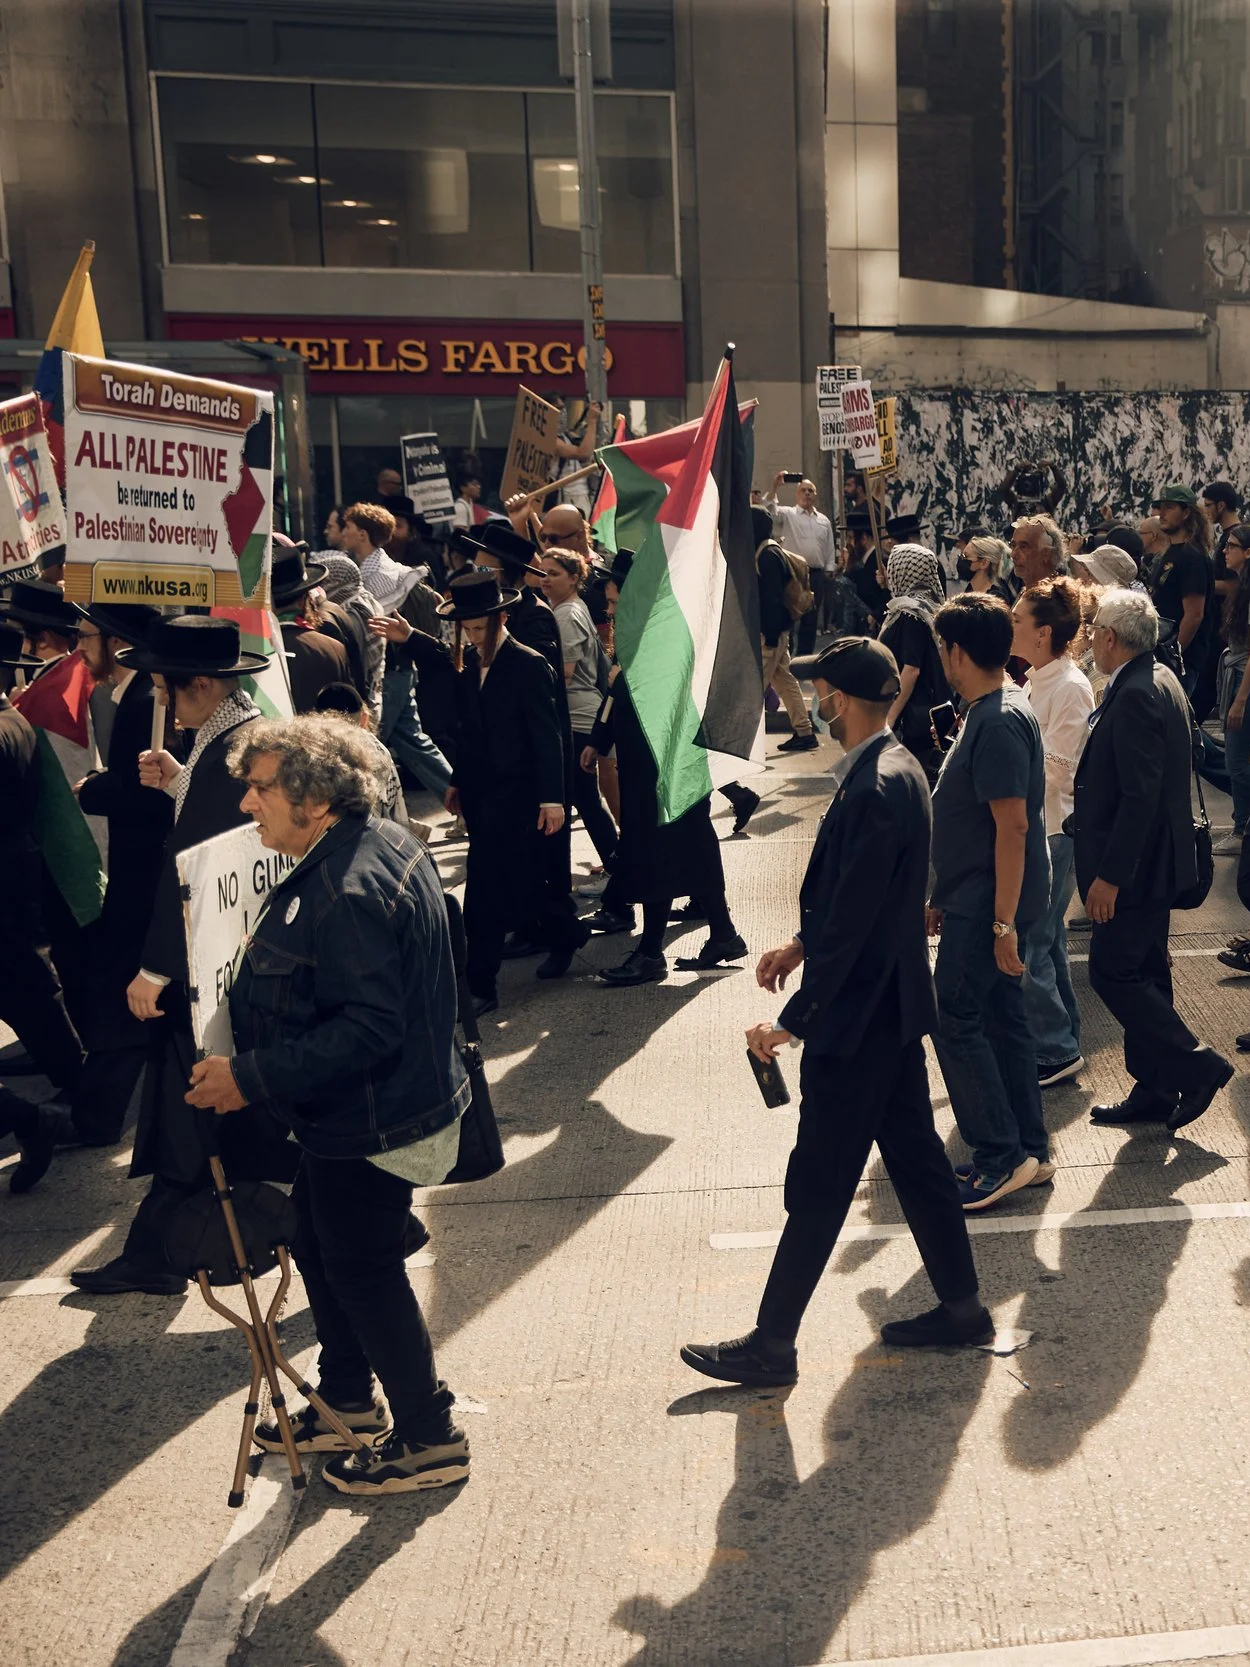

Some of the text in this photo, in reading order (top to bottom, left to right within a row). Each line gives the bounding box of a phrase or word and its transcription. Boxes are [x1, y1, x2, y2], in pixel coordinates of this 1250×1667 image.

[441, 340, 613, 375] FARGO
[820, 368, 858, 381] FREE
[101, 374, 240, 420] Torah Demands
[842, 388, 870, 415] ARMS
[522, 395, 549, 437] FREE
[822, 421, 845, 436] GENOC
[74, 431, 228, 483] ALL PALESTINE
[117, 481, 195, 511] be returned to
[75, 511, 218, 554] Palestinian Sovereignty
[103, 575, 208, 602] www.nkusa.org
[217, 871, 239, 914] NO
